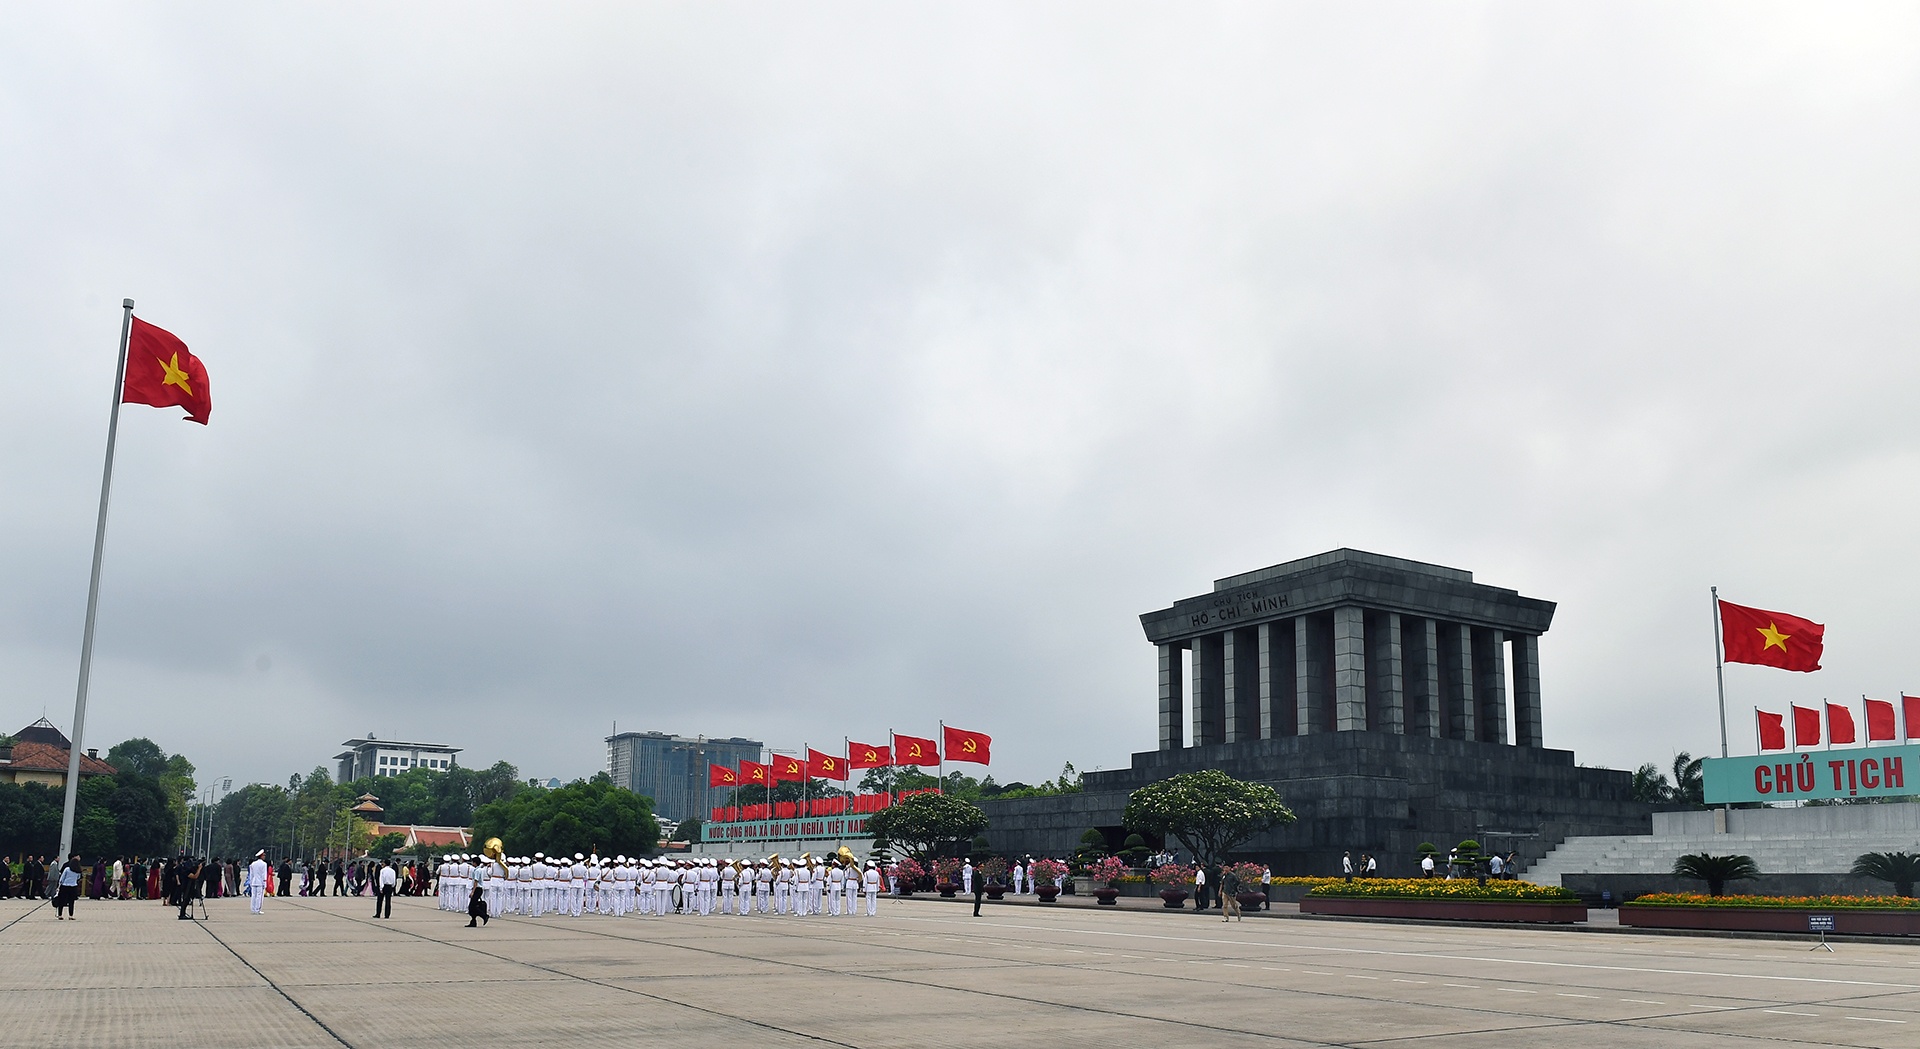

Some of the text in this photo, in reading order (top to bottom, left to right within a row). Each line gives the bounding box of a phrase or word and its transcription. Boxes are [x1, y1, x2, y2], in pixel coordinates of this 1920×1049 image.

[1755, 754, 1904, 795] CHỦ TỊCH
[709, 825, 724, 839] NƯỚC
[726, 824, 743, 840] CỘNG
[744, 823, 757, 837] HÒA
[759, 822, 768, 837] XÃ
[770, 821, 782, 838] HỘI
[784, 820, 798, 836] CHỦ
[801, 819, 824, 835] NGHĨA
[828, 818, 845, 836] VIỆT
